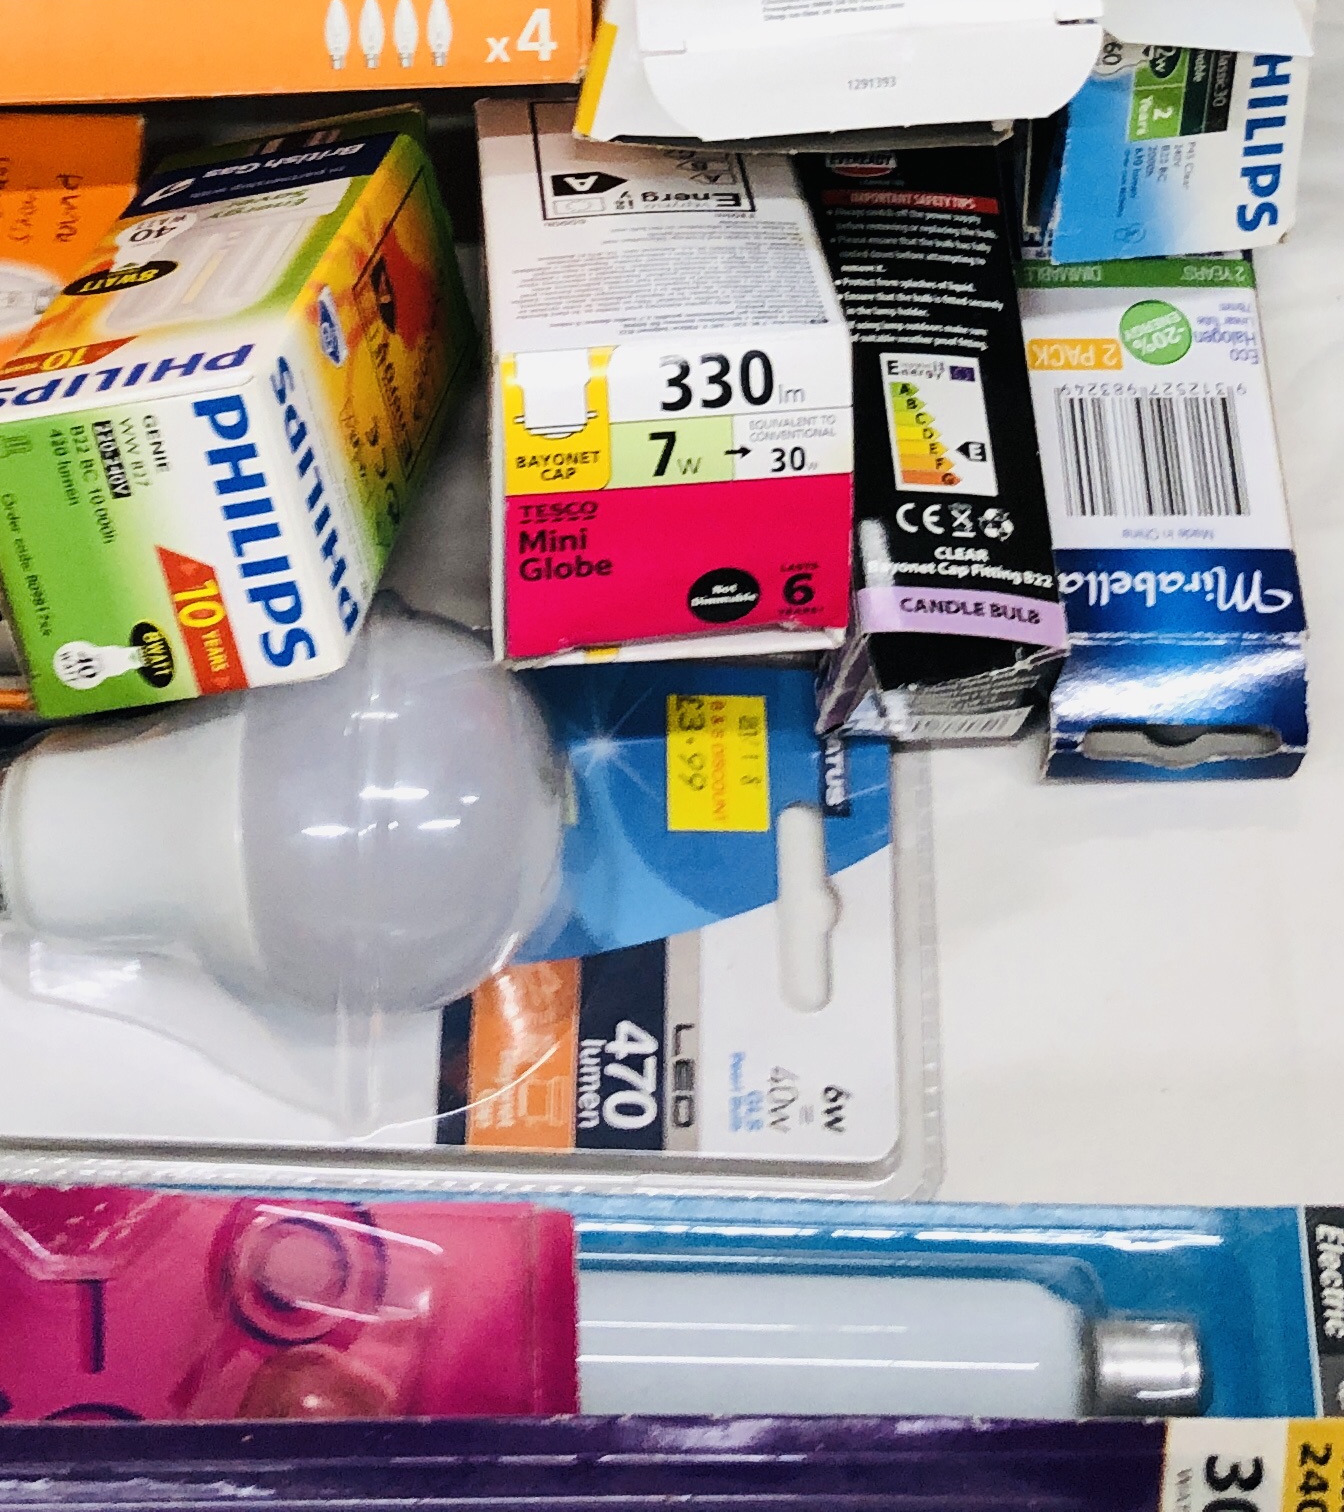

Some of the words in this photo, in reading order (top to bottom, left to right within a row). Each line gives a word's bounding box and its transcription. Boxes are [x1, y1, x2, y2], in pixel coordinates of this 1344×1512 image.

[484, 8, 558, 63] x4
[1135, 95, 1154, 136] Years
[1154, 106, 1173, 121] 2
[202, 159, 262, 180] Gas
[264, 142, 366, 171] British
[563, 174, 600, 192] A
[129, 225, 179, 244] 40
[41, 346, 86, 372] 10
[1033, 343, 1096, 366] PACK
[1102, 344, 1118, 364] 2
[915, 412, 927, 425] C
[142, 414, 171, 474] GENIE
[922, 428, 934, 440] D
[514, 450, 601, 470] BAYONET
[929, 443, 938, 455] E
[968, 441, 984, 461] E
[540, 466, 577, 482] CAP
[936, 457, 944, 470] F
[518, 501, 599, 526] TESCO
[895, 503, 946, 536] CE
[191, 394, 317, 668] PHILIPS
[518, 527, 589, 554] Mini
[933, 546, 990, 563] CLEAR
[518, 555, 614, 583] Globe
[937, 562, 970, 578] Cap
[971, 563, 1023, 586] Fitting
[1023, 570, 1054, 589] B22
[783, 572, 815, 606] 6
[1058, 565, 1294, 614] Mirabella
[173, 579, 227, 629] 10
[899, 597, 986, 617] CANDLE
[989, 603, 1041, 625] BULB
[576, 1037, 608, 1130] lumen
[602, 1018, 660, 1132] 470
